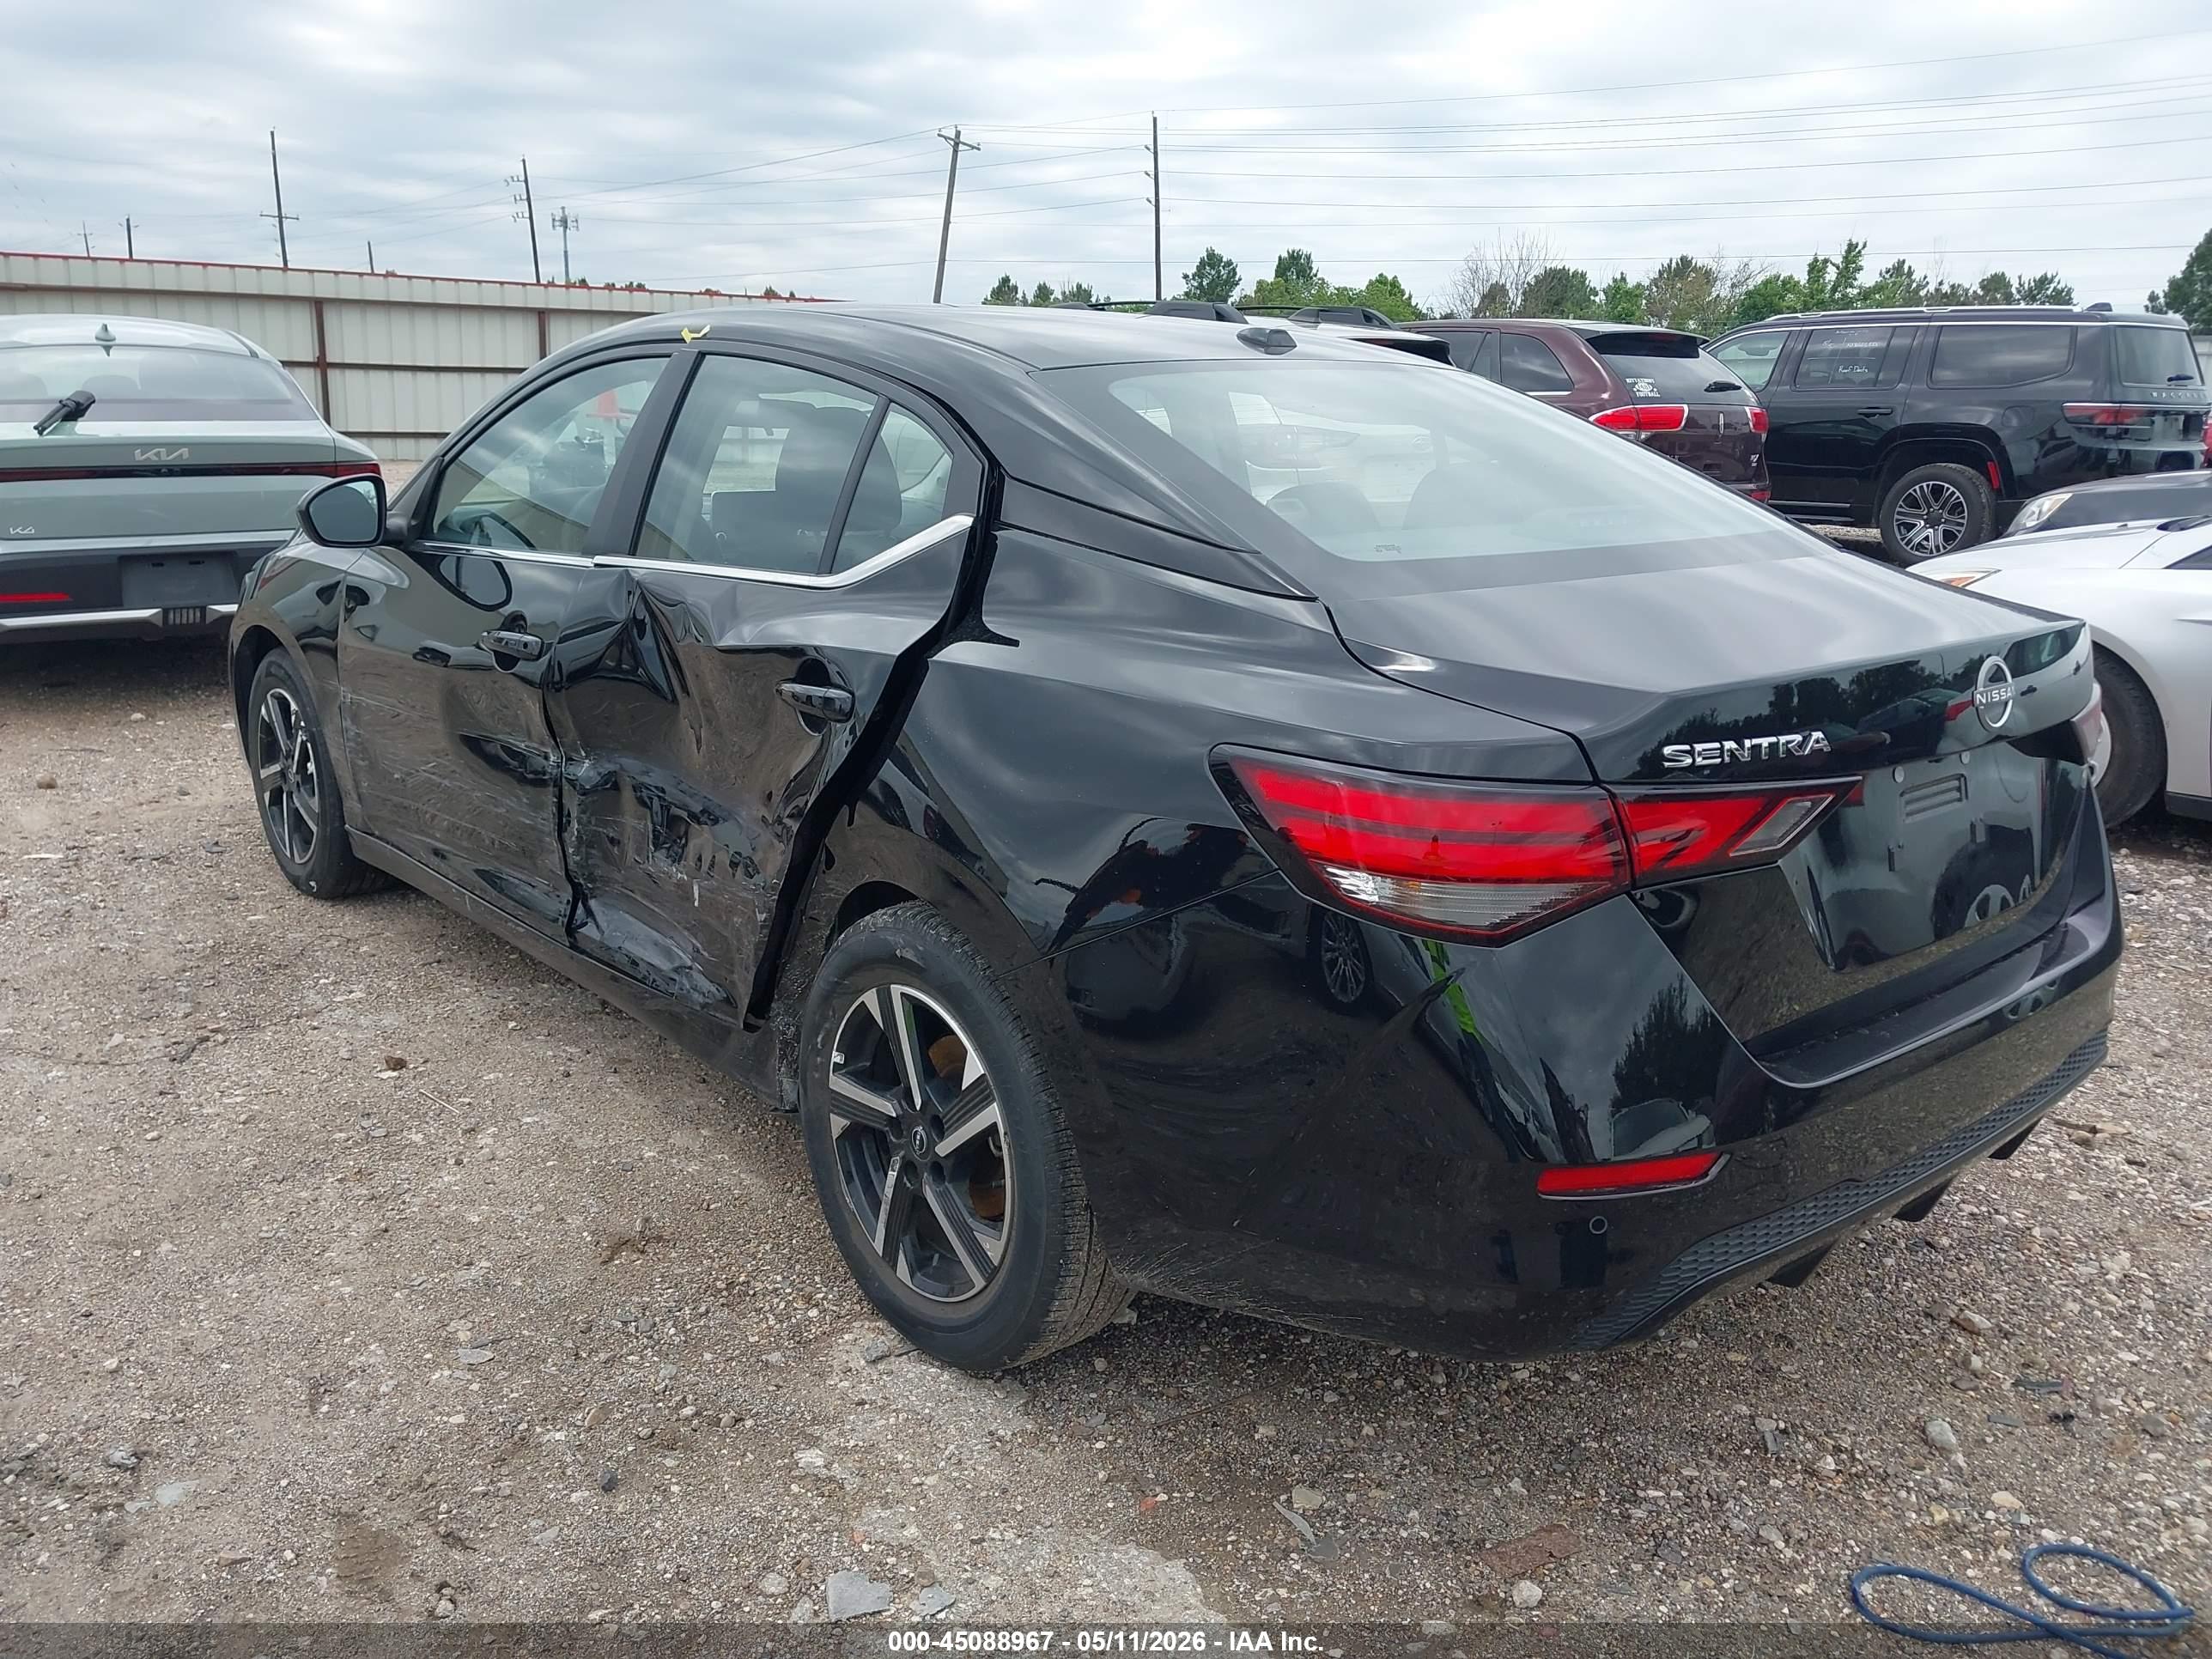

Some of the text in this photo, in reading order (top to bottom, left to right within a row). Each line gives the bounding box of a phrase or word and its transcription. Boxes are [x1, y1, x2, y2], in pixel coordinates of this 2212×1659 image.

[134, 447, 189, 461] KIA
[9, 526, 35, 535] K4
[1662, 731, 1832, 769] SENTRA
